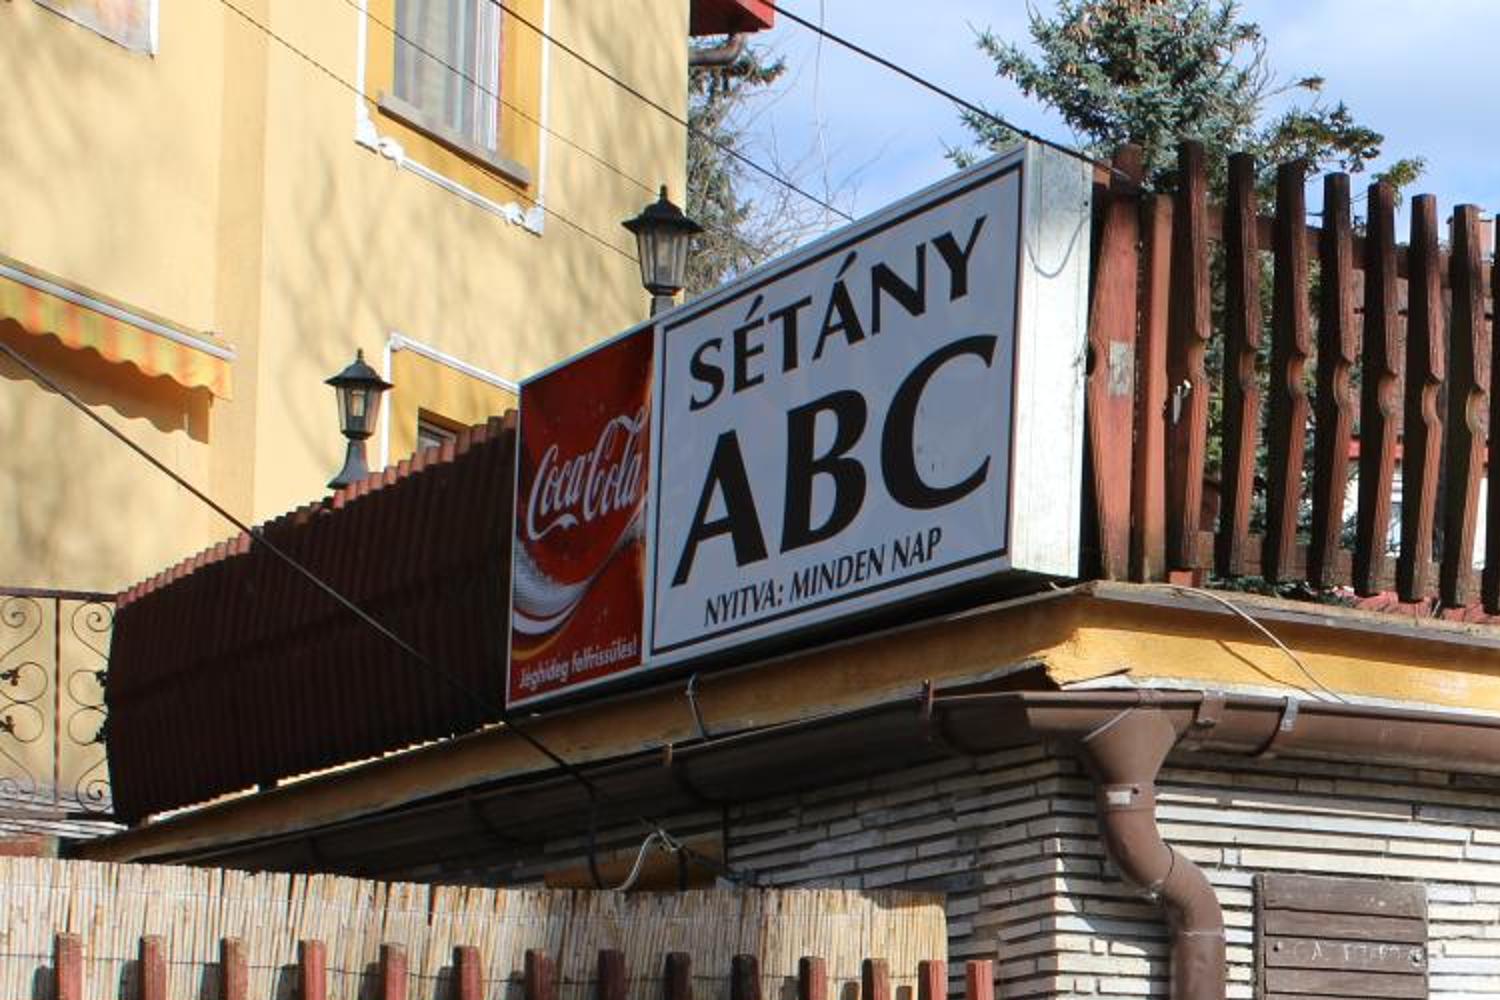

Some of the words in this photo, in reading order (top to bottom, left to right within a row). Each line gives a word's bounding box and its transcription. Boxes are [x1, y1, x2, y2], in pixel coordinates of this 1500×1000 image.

[689, 214, 988, 412] SÉTÁNY
[526, 404, 648, 541] Coca-Cola
[670, 334, 999, 588] ABC
[703, 578, 785, 628] NYITVA:
[789, 547, 896, 602] MINDEN
[890, 526, 943, 576] NAP
